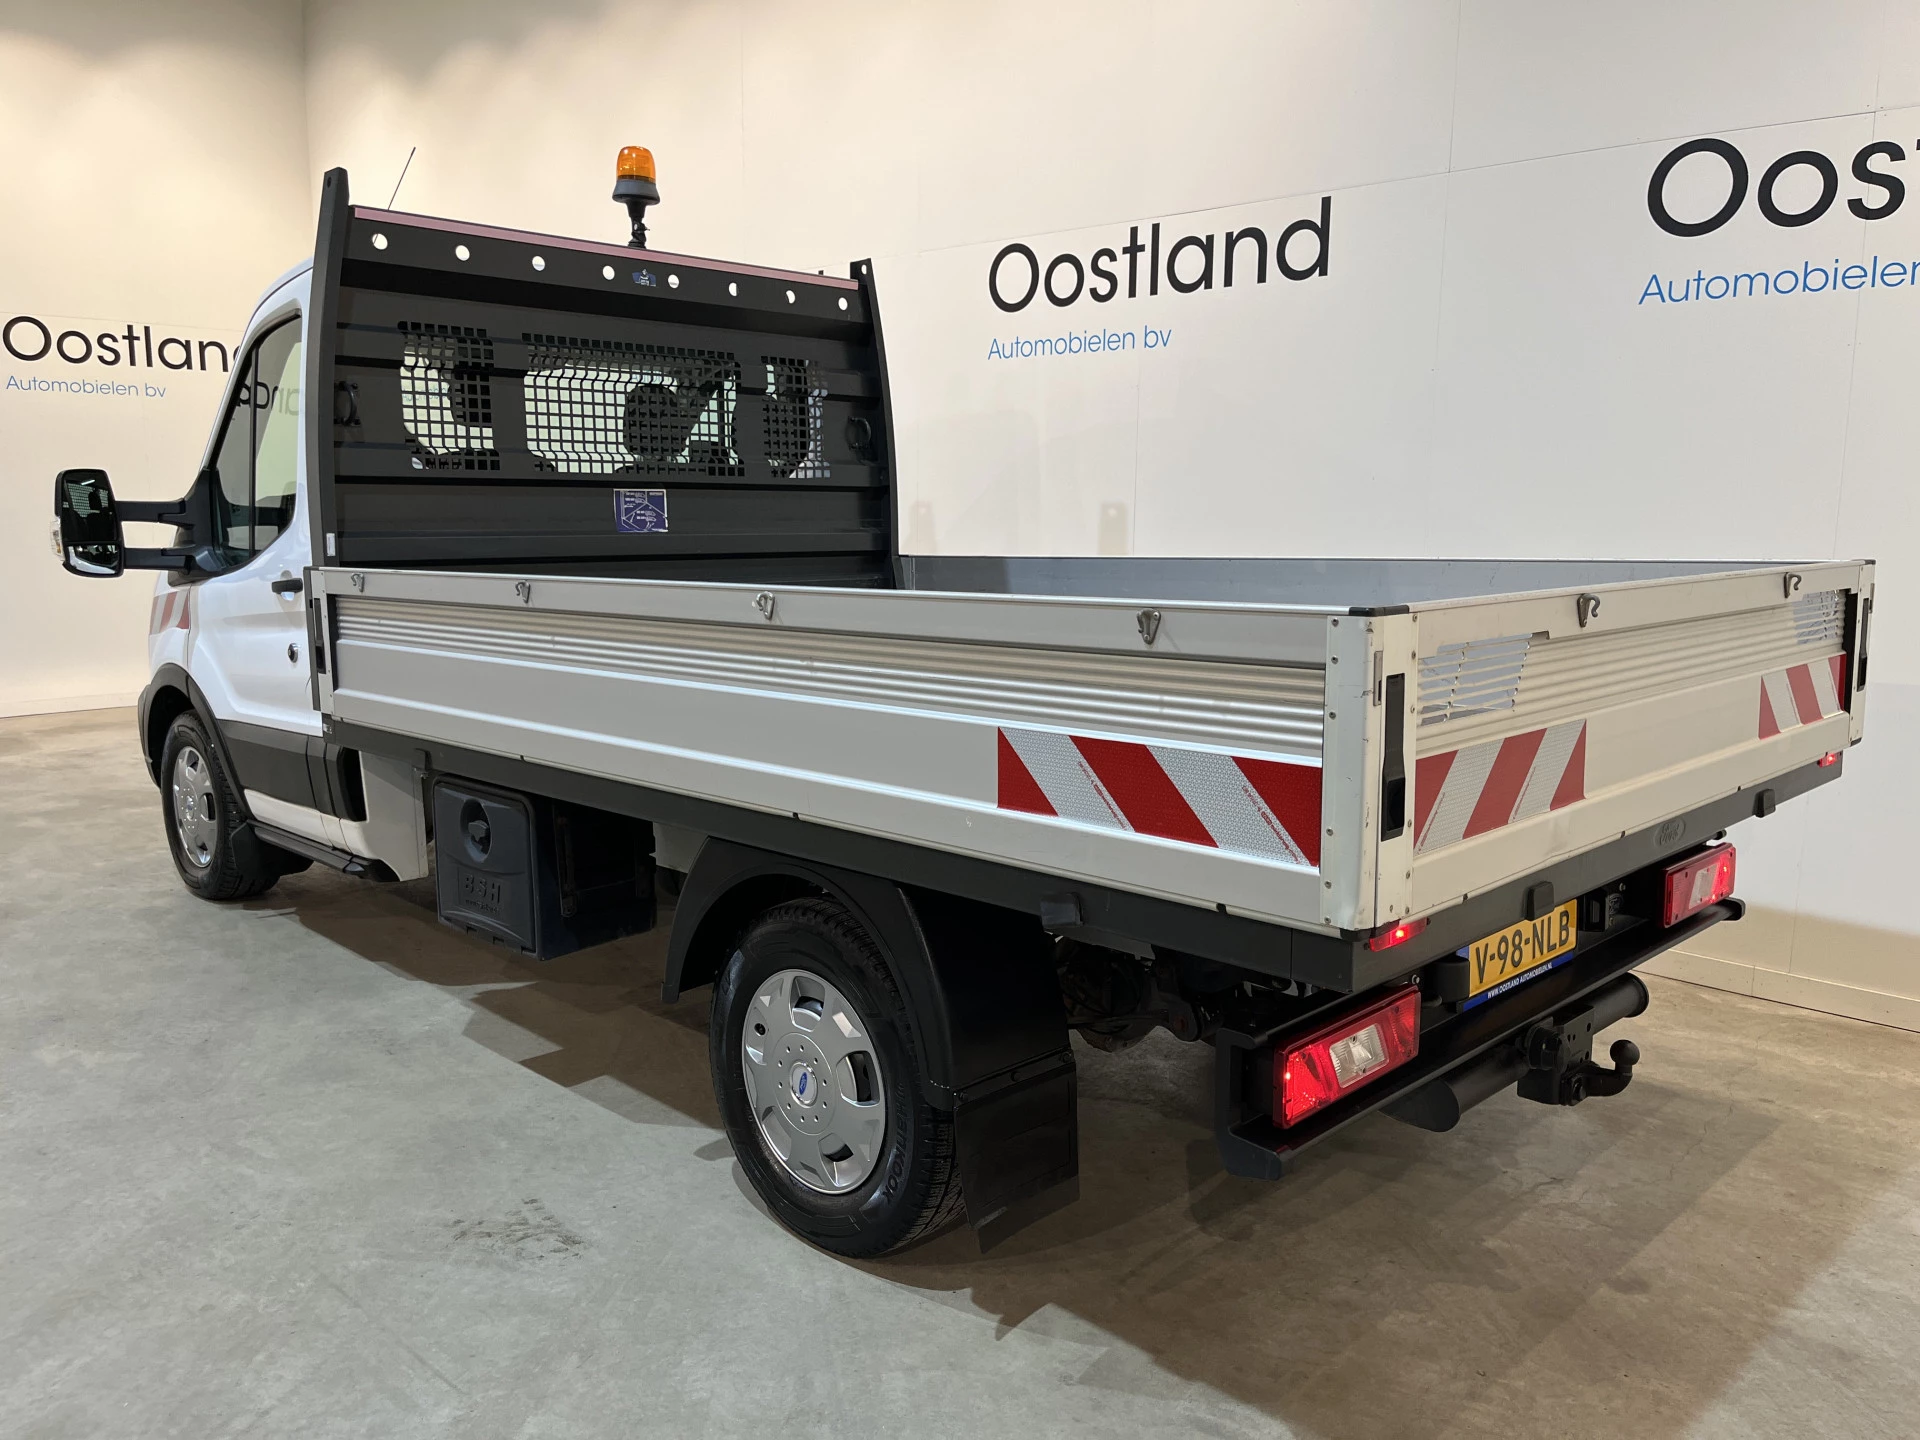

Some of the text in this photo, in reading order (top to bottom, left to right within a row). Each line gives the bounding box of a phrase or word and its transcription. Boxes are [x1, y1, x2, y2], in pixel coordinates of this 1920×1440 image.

[1647, 137, 1920, 238] Oos
[988, 195, 1332, 313] Oostland
[2, 315, 241, 373] Oostlan
[988, 324, 1172, 361] Automobielen bv
[6, 375, 167, 398] Automobielen bv
[1475, 909, 1570, 985] V-98-NLB
